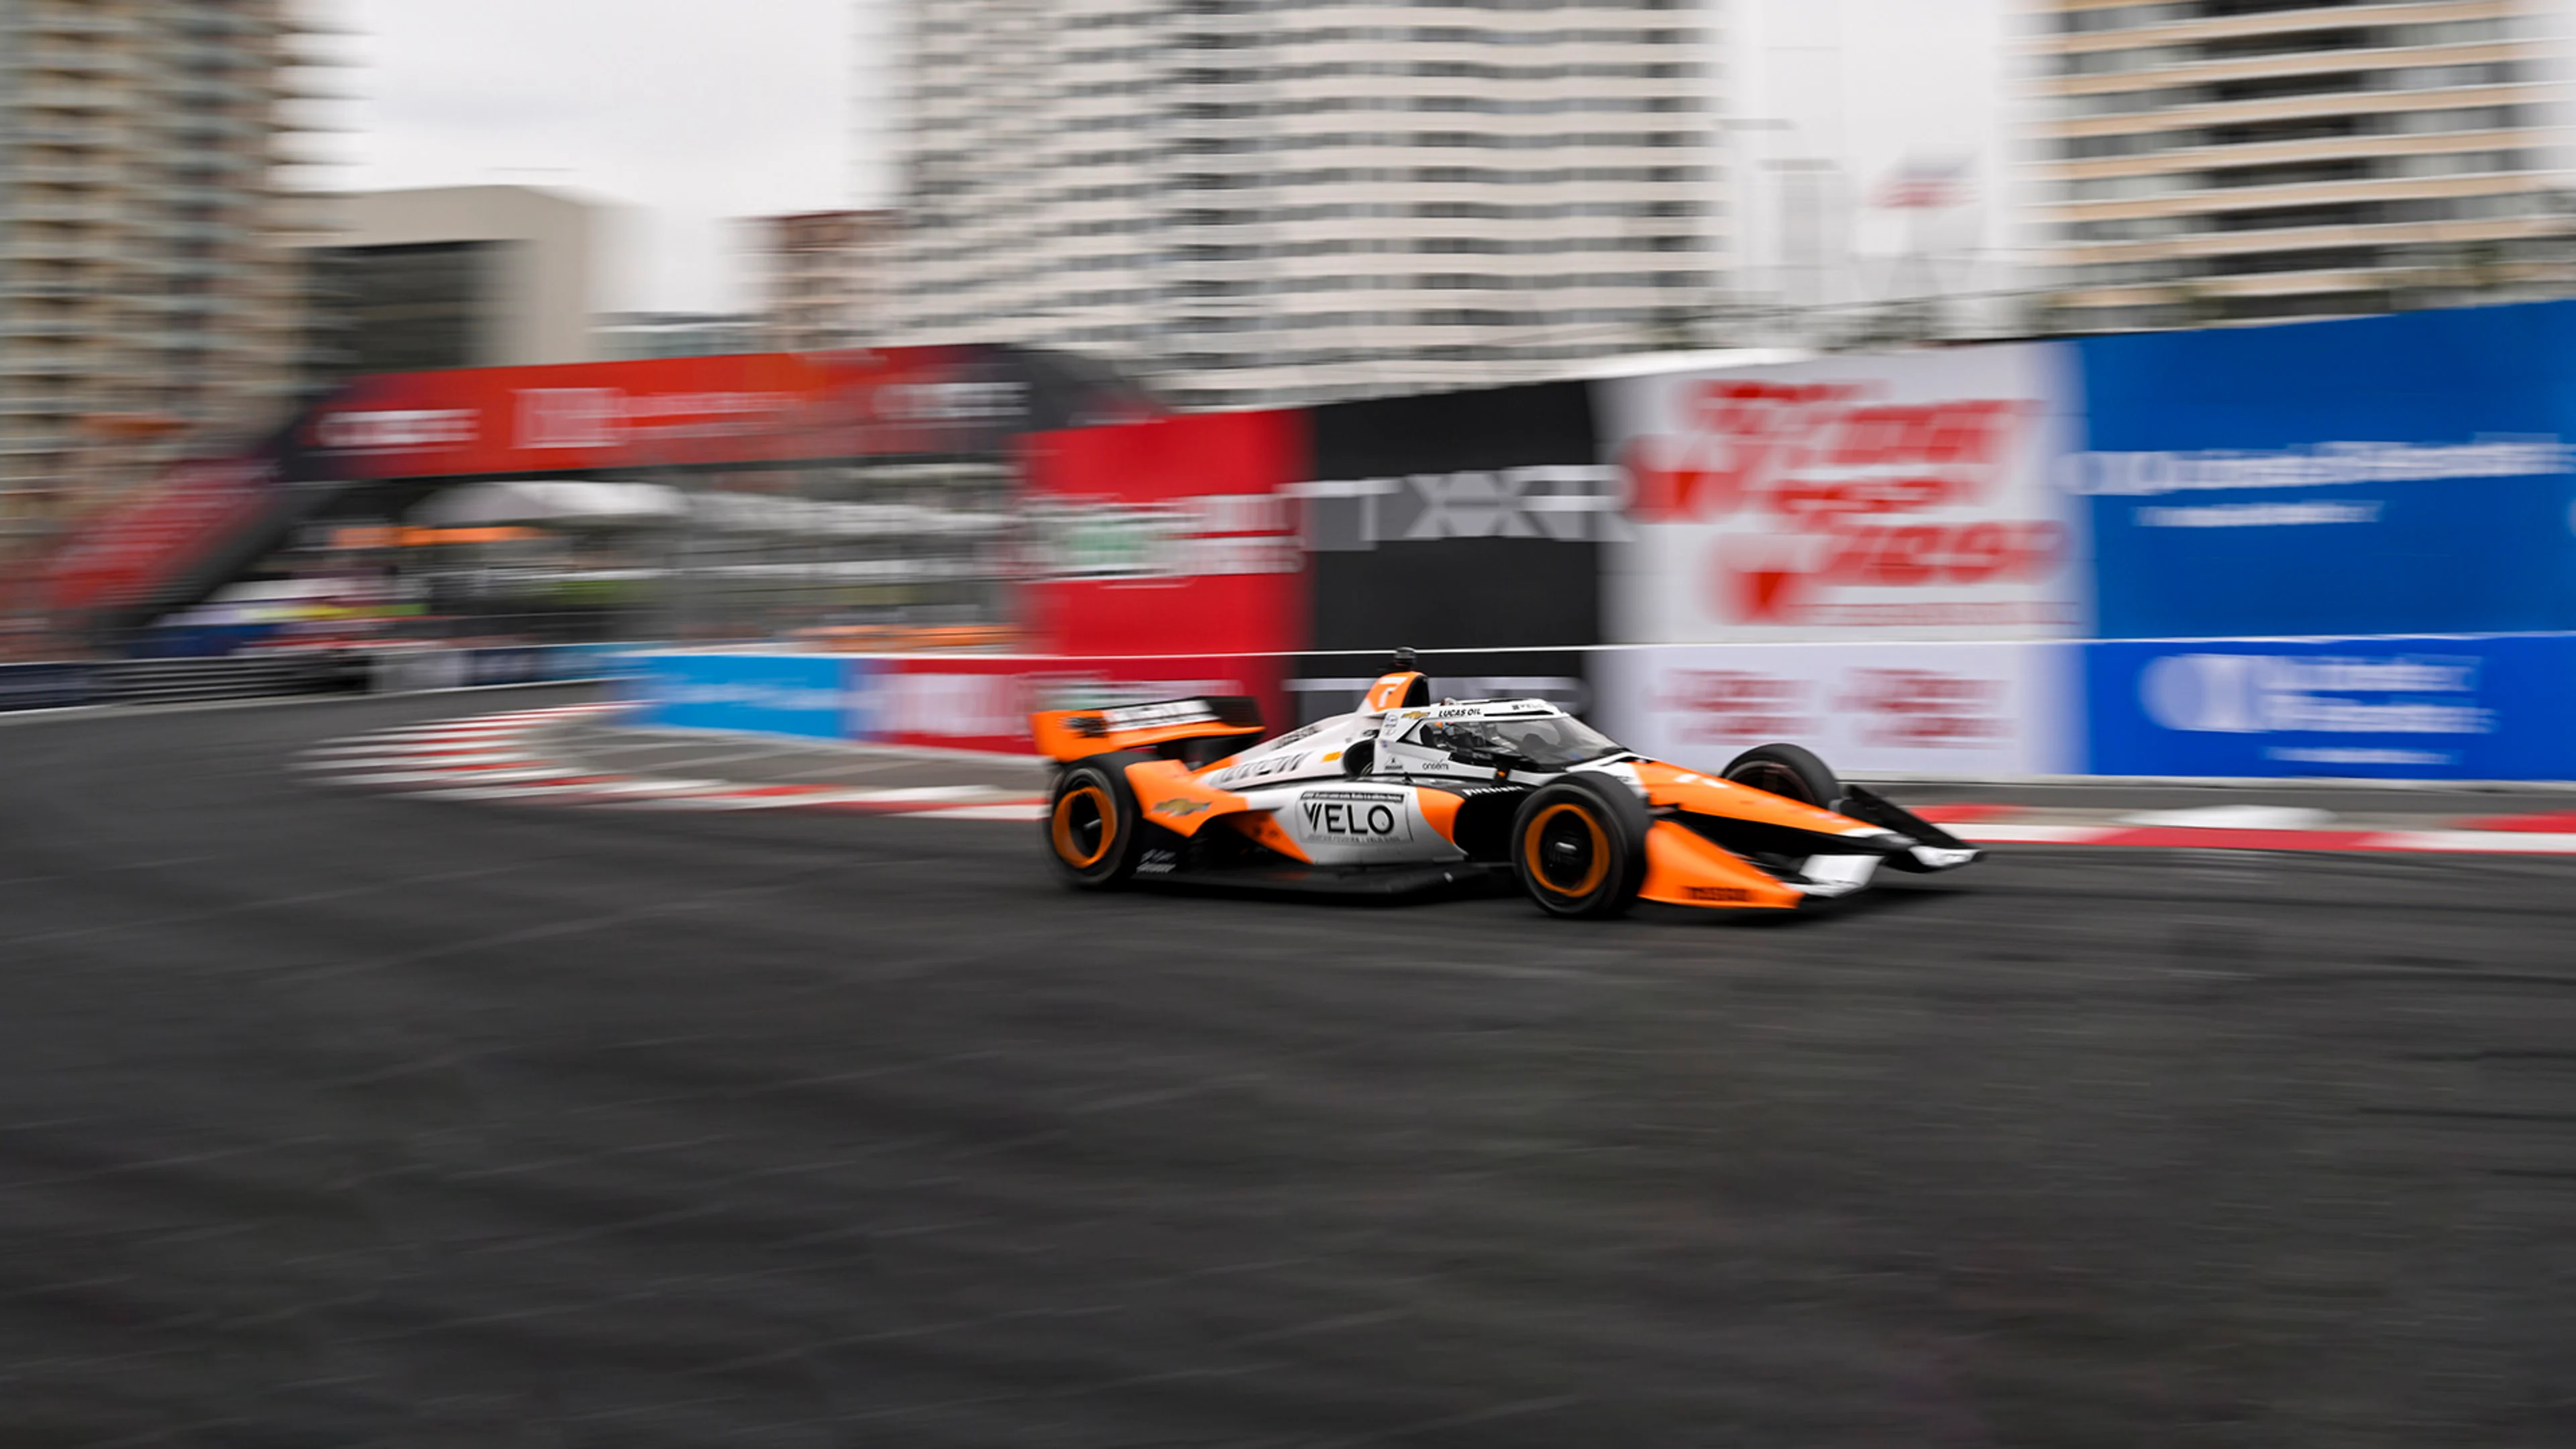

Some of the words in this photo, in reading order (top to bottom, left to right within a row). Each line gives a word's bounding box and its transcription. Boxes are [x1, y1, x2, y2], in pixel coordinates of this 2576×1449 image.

[1378, 676, 1407, 708] 7
[1439, 709, 1465, 717] LUCAS
[1303, 802, 1395, 835] VELO
